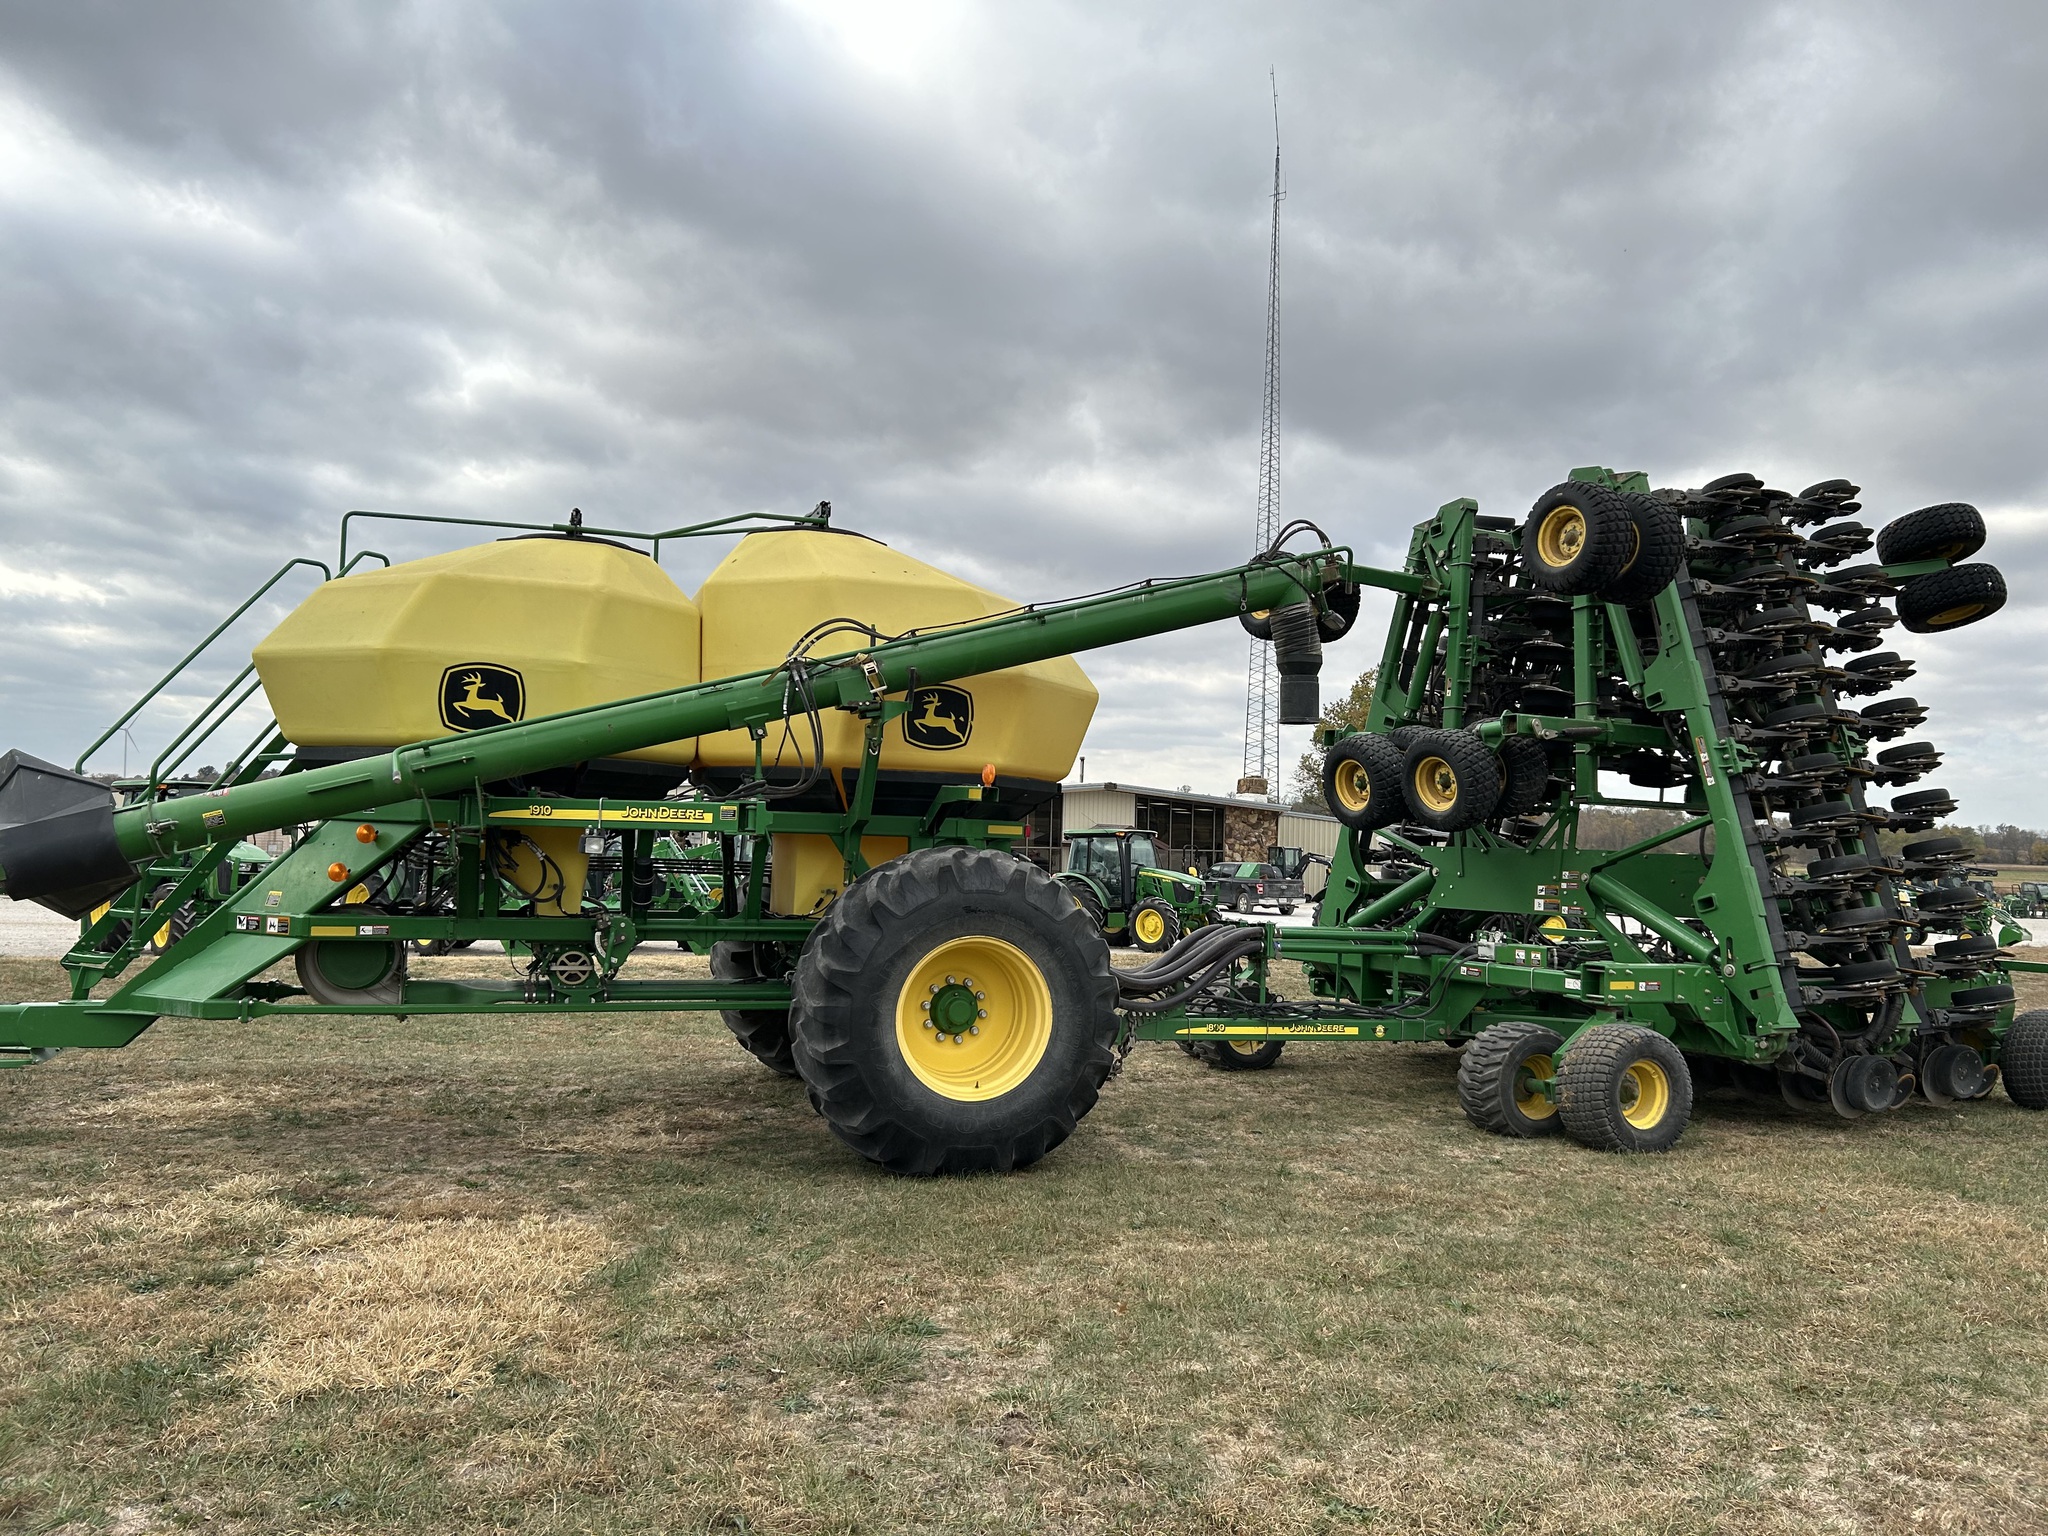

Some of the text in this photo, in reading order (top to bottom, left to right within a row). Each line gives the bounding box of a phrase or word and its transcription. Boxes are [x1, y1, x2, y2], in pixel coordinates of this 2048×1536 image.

[529, 805, 552, 816] 1910
[622, 806, 705, 820] JOHN DEERE
[1289, 1023, 1346, 1033] JOHN DEERE
